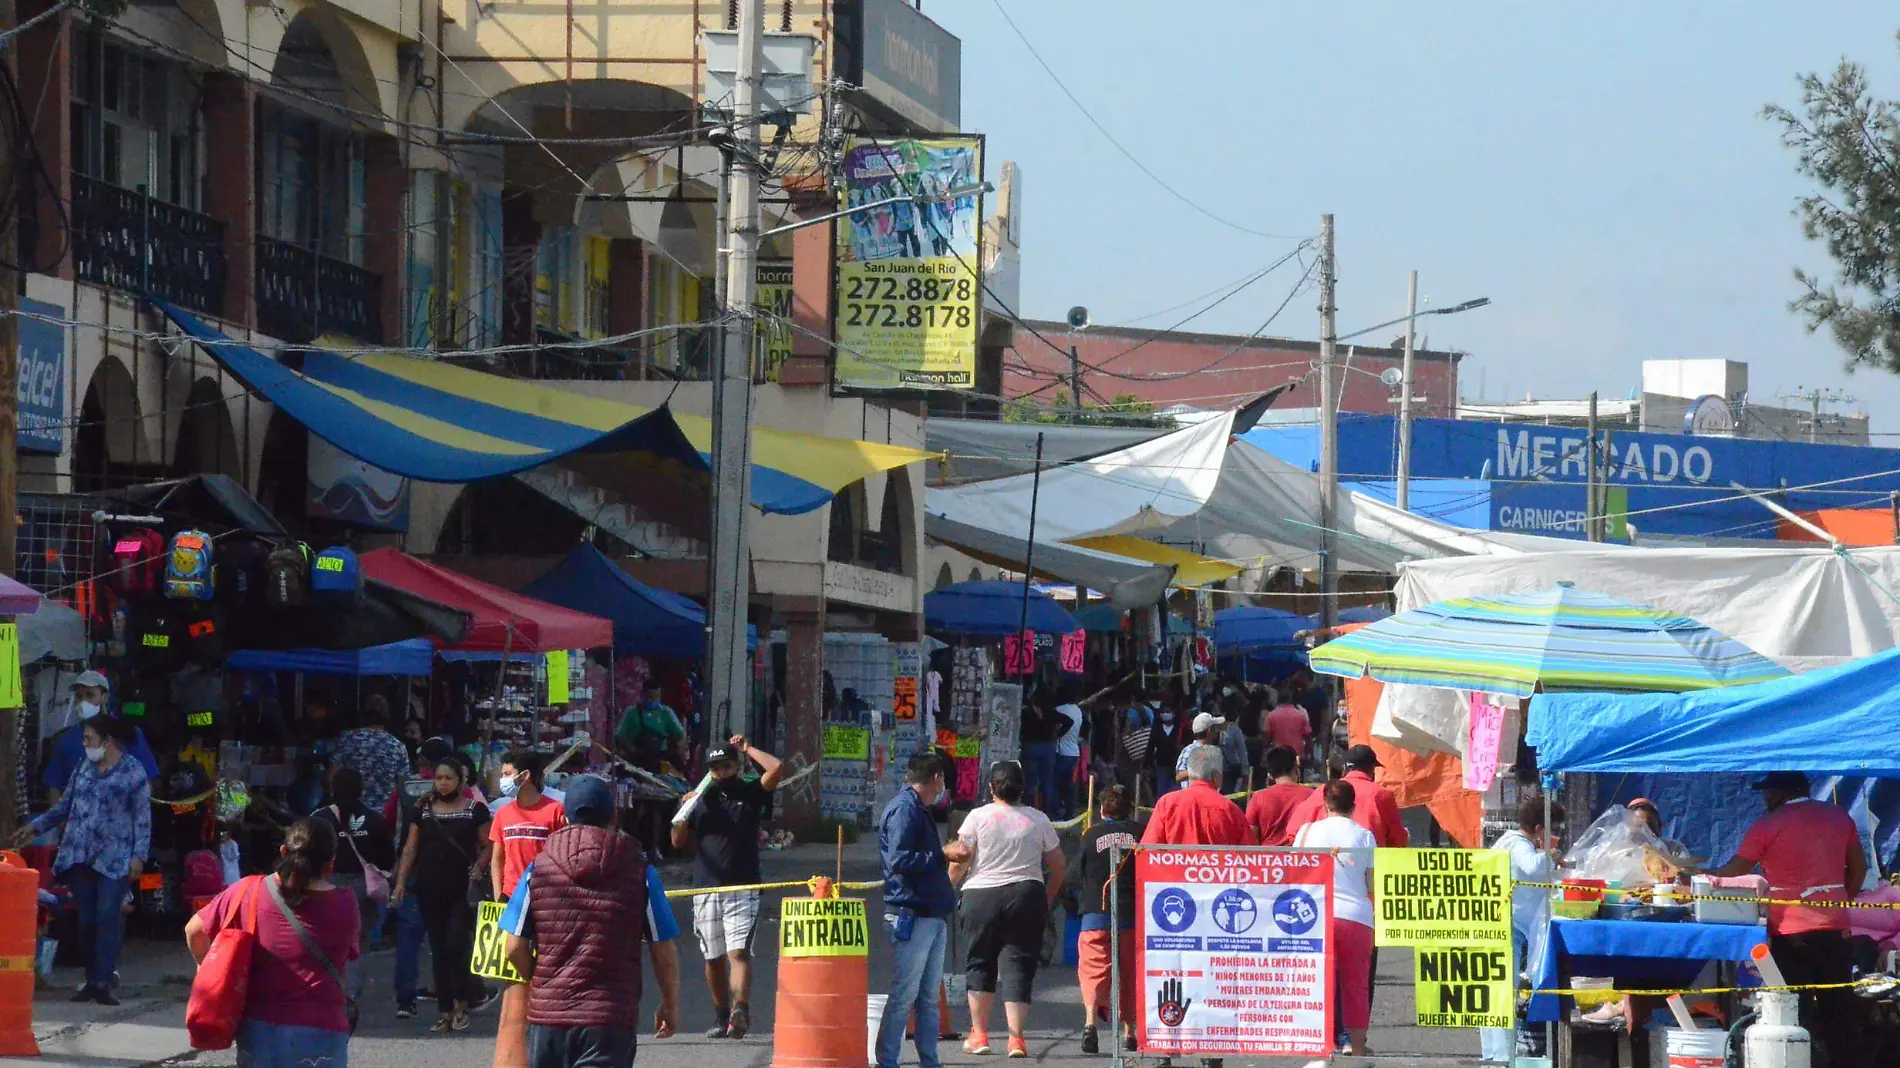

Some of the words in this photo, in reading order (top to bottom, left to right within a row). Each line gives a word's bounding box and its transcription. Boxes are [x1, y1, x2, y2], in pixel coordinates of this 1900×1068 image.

[864, 262, 885, 273] San
[888, 263, 914, 274] Juan
[918, 263, 935, 274] del
[847, 276, 970, 301] 272.8878
[846, 303, 970, 328] 272.8178
[947, 372, 966, 383] hall
[1497, 429, 1712, 483] MERCADO
[1500, 505, 1615, 535] CARNICERS
[1149, 853, 1219, 866] NORMAS
[1224, 854, 1320, 867] SANITARIAS
[1417, 852, 1449, 871] USO
[1454, 852, 1473, 871] DE
[1184, 867, 1284, 883] COVID-19
[1383, 874, 1501, 897] CUBREBOCAS
[1383, 899, 1501, 922] OBLIGATORIO
[783, 919, 865, 947] ENTRADA
[1385, 928, 1401, 938] POR
[1403, 929, 1413, 939] TU
[1415, 927, 1470, 940] COMPRENSIÓN
[1473, 929, 1507, 940] GRACIAS
[473, 922, 519, 979] SAL
[1210, 956, 1256, 967] PROHIBIDA
[1258, 957, 1269, 968] LA
[1271, 957, 1308, 968] ENTRADA
[1310, 958, 1316, 968] A
[1420, 947, 1506, 981] NIÑOS
[1215, 971, 1238, 981] NIÑOS
[1239, 972, 1273, 982] MENORES
[1274, 972, 1284, 982] DE
[1297, 972, 1316, 983] AÑOS
[1221, 985, 1253, 996] MUJERES
[1255, 986, 1311, 996] EMBARAZADAS
[1248, 1000, 1257, 1009] DE
[1259, 1000, 1269, 1009] LA
[1271, 1000, 1301, 1010] TERCERA
[1304, 1000, 1323, 1010] EDAD
[1440, 984, 1490, 1013] NO
[1239, 1013, 1277, 1023] PERSONAS
[1280, 1014, 1293, 1023] CON
[1419, 1014, 1456, 1026] PUEDEN
[1461, 1015, 1509, 1028] INGRESAR
[1206, 1026, 1263, 1037] ENFERMEDADES
[1265, 1028, 1322, 1038] RESPIRATORIAS
[1182, 1040, 1198, 1049] CON
[1243, 1042, 1253, 1050] TU
[1255, 1042, 1283, 1051] FAMILIA
